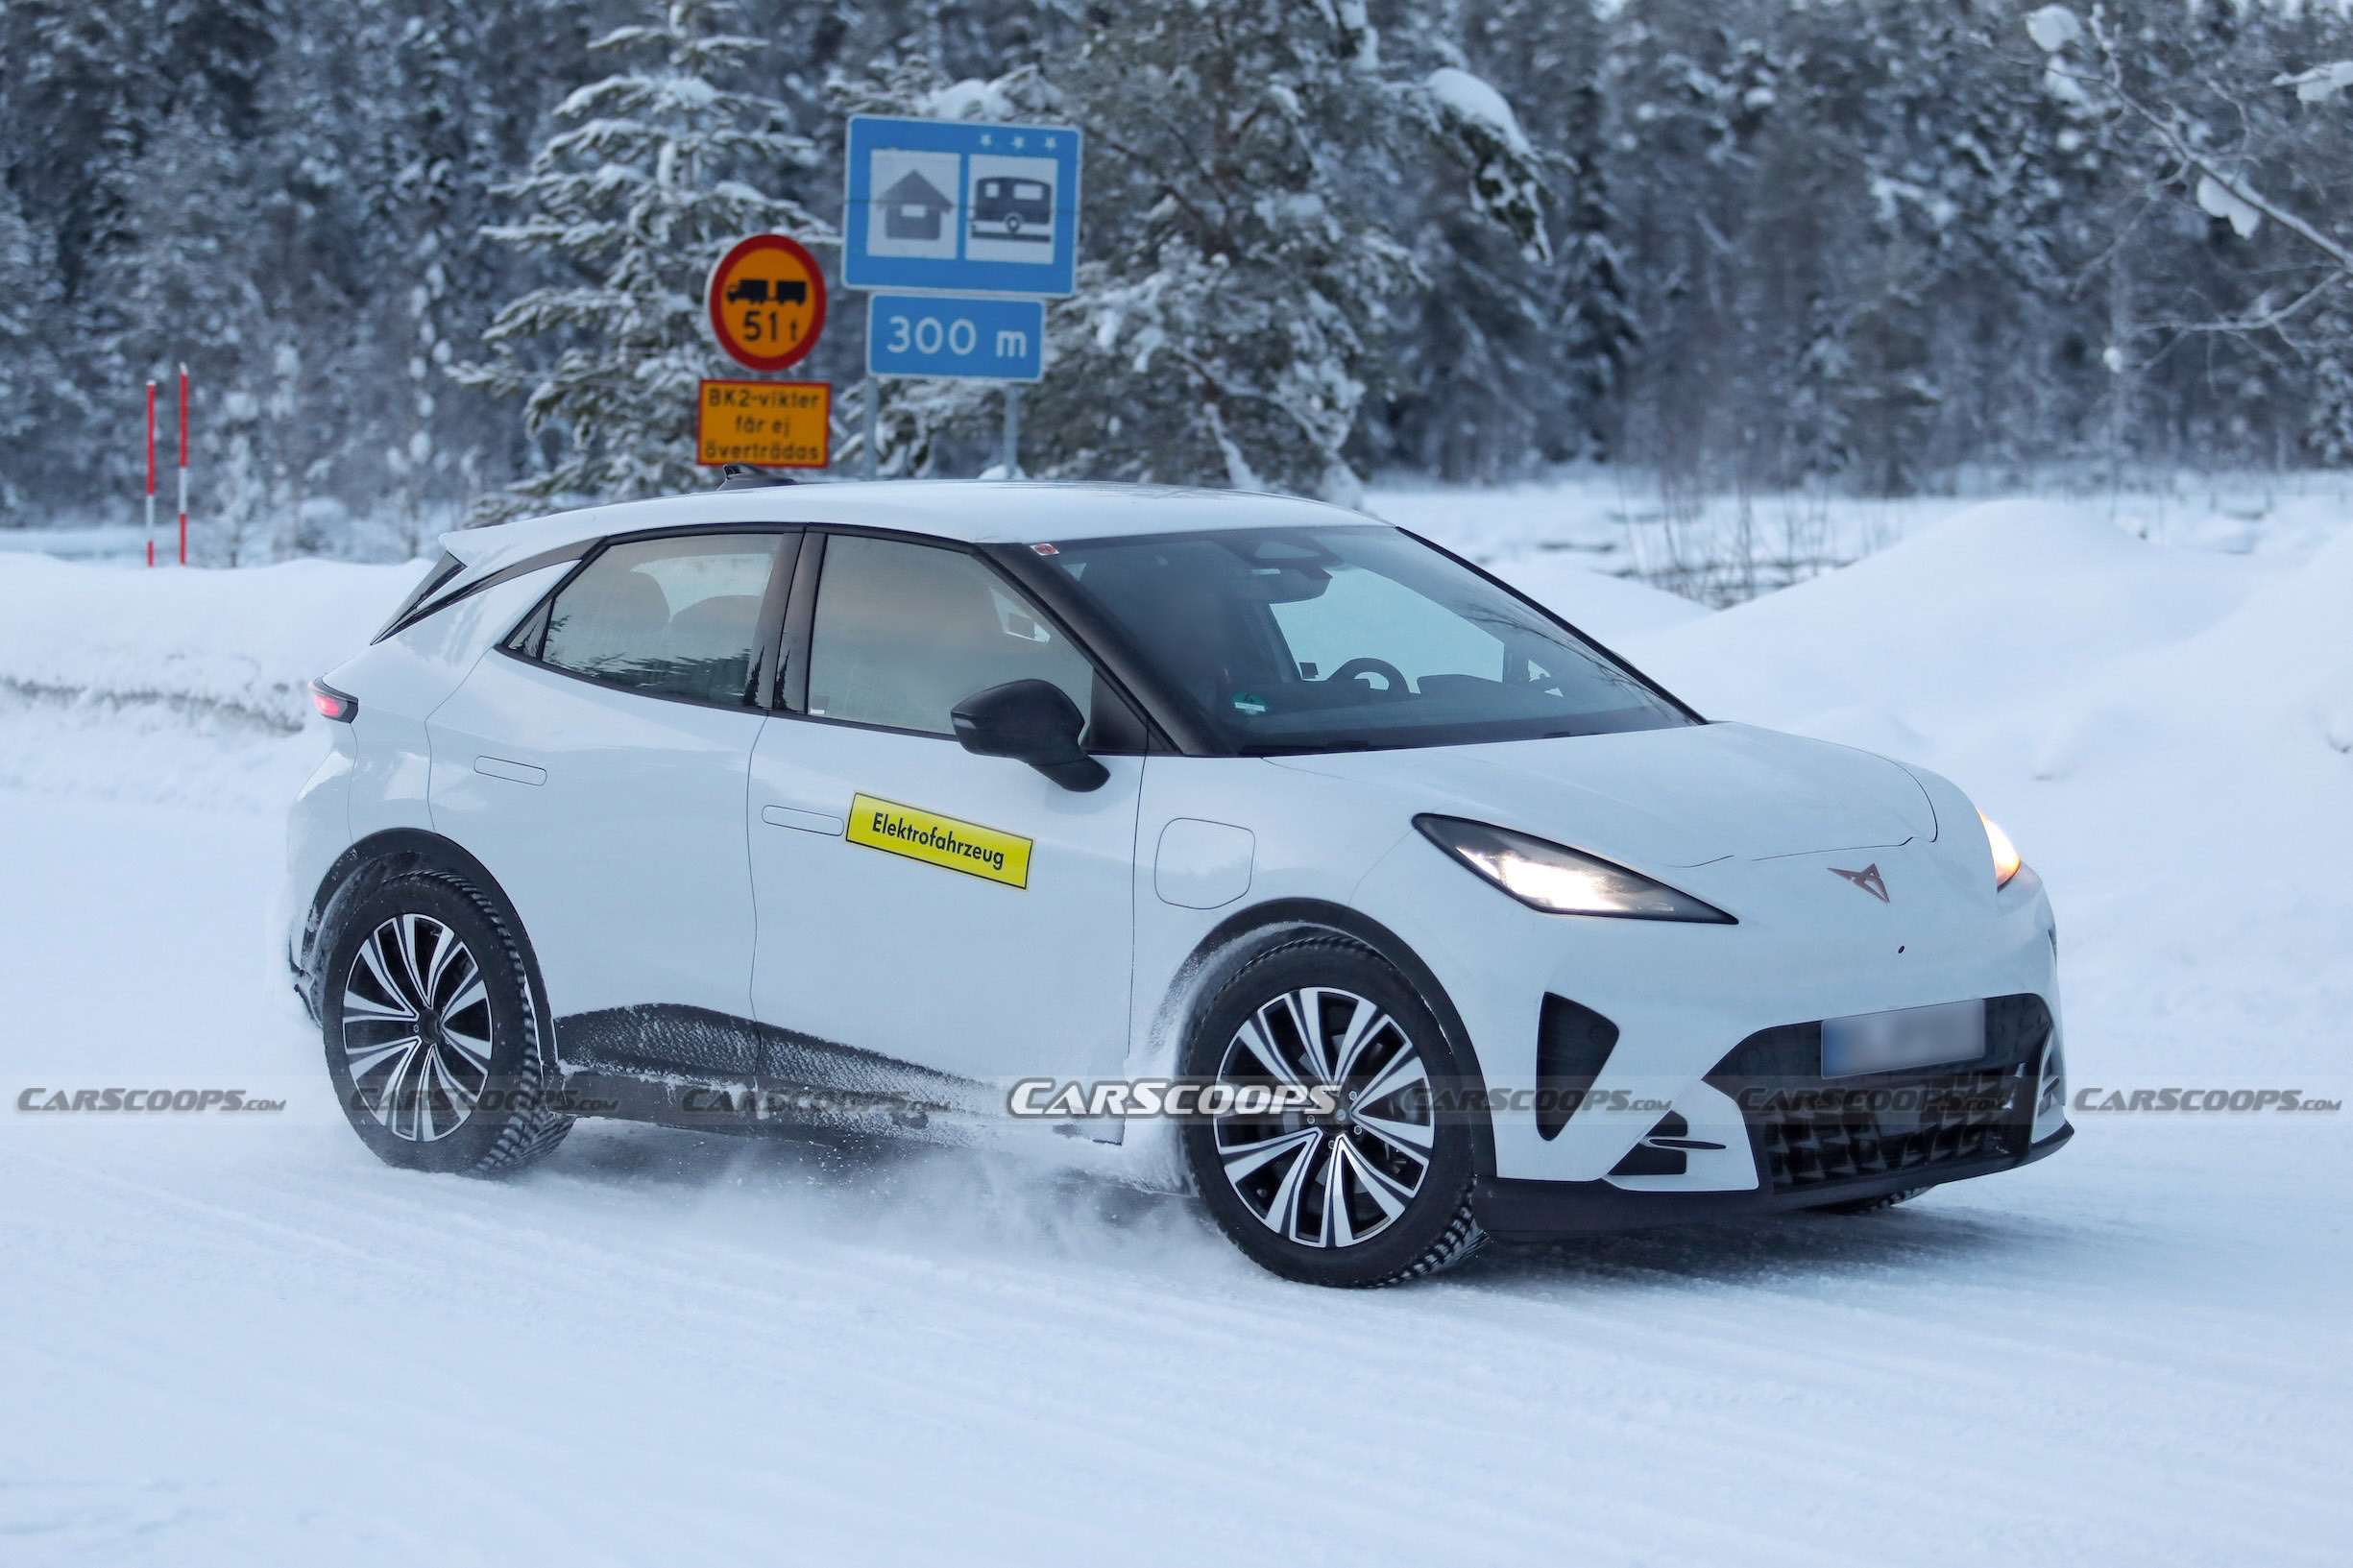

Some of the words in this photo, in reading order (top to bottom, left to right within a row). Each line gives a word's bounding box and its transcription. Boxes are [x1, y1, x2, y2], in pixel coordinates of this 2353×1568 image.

[742, 310, 778, 342] 51
[790, 320, 800, 343] t
[886, 315, 977, 356] 300
[995, 329, 1028, 358] m
[709, 388, 819, 408] BK2-vikter
[771, 416, 790, 439] ej
[706, 439, 818, 460] överträdas
[871, 811, 1006, 871] Elektrofahrzeug
